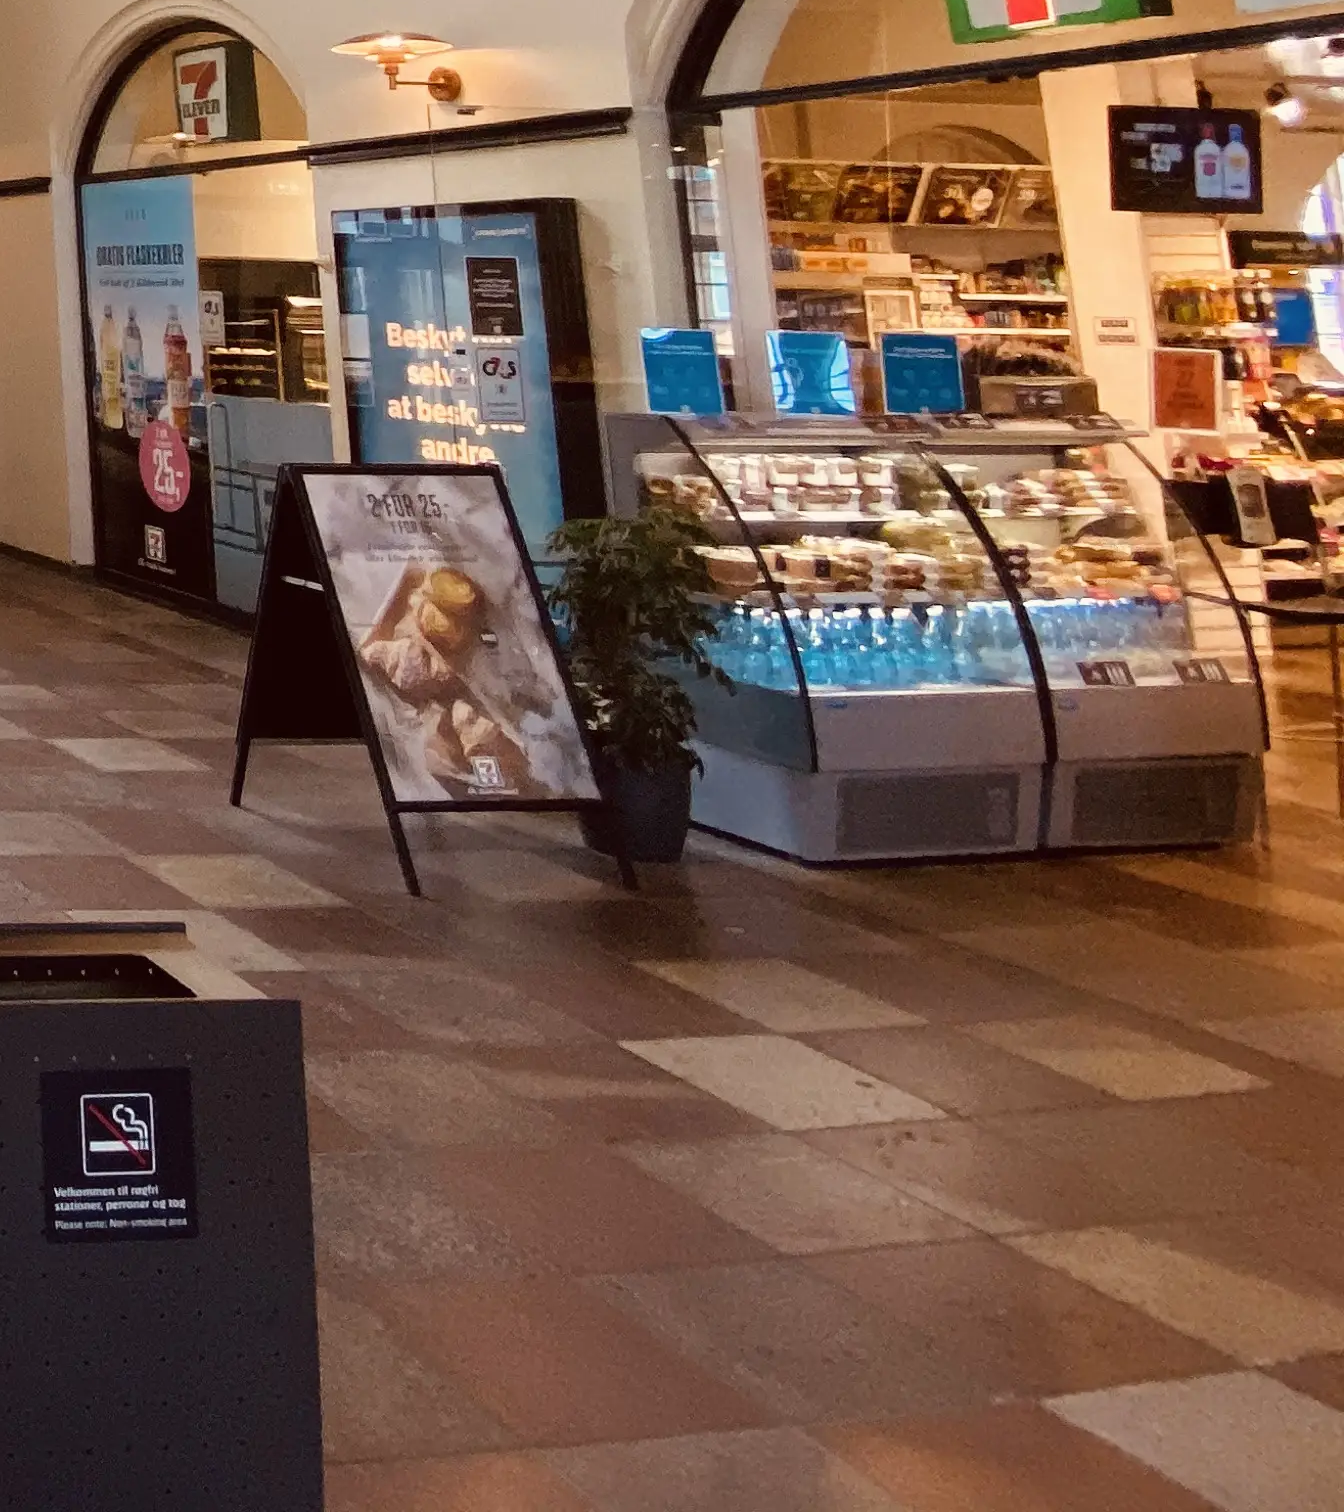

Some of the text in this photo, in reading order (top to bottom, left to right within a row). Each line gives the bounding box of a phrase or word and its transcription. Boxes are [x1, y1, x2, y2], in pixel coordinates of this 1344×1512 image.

[97, 246, 124, 266] GRATIS
[387, 395, 413, 420] at
[420, 436, 501, 465] andre
[366, 493, 382, 518] 2
[382, 494, 416, 517] FOR
[53, 1184, 159, 1198] Velkommen til røgfri
[54, 1197, 186, 1212] stationer, perroner og tog
[54, 1220, 83, 1230] Please
[168, 1217, 188, 1227] area
